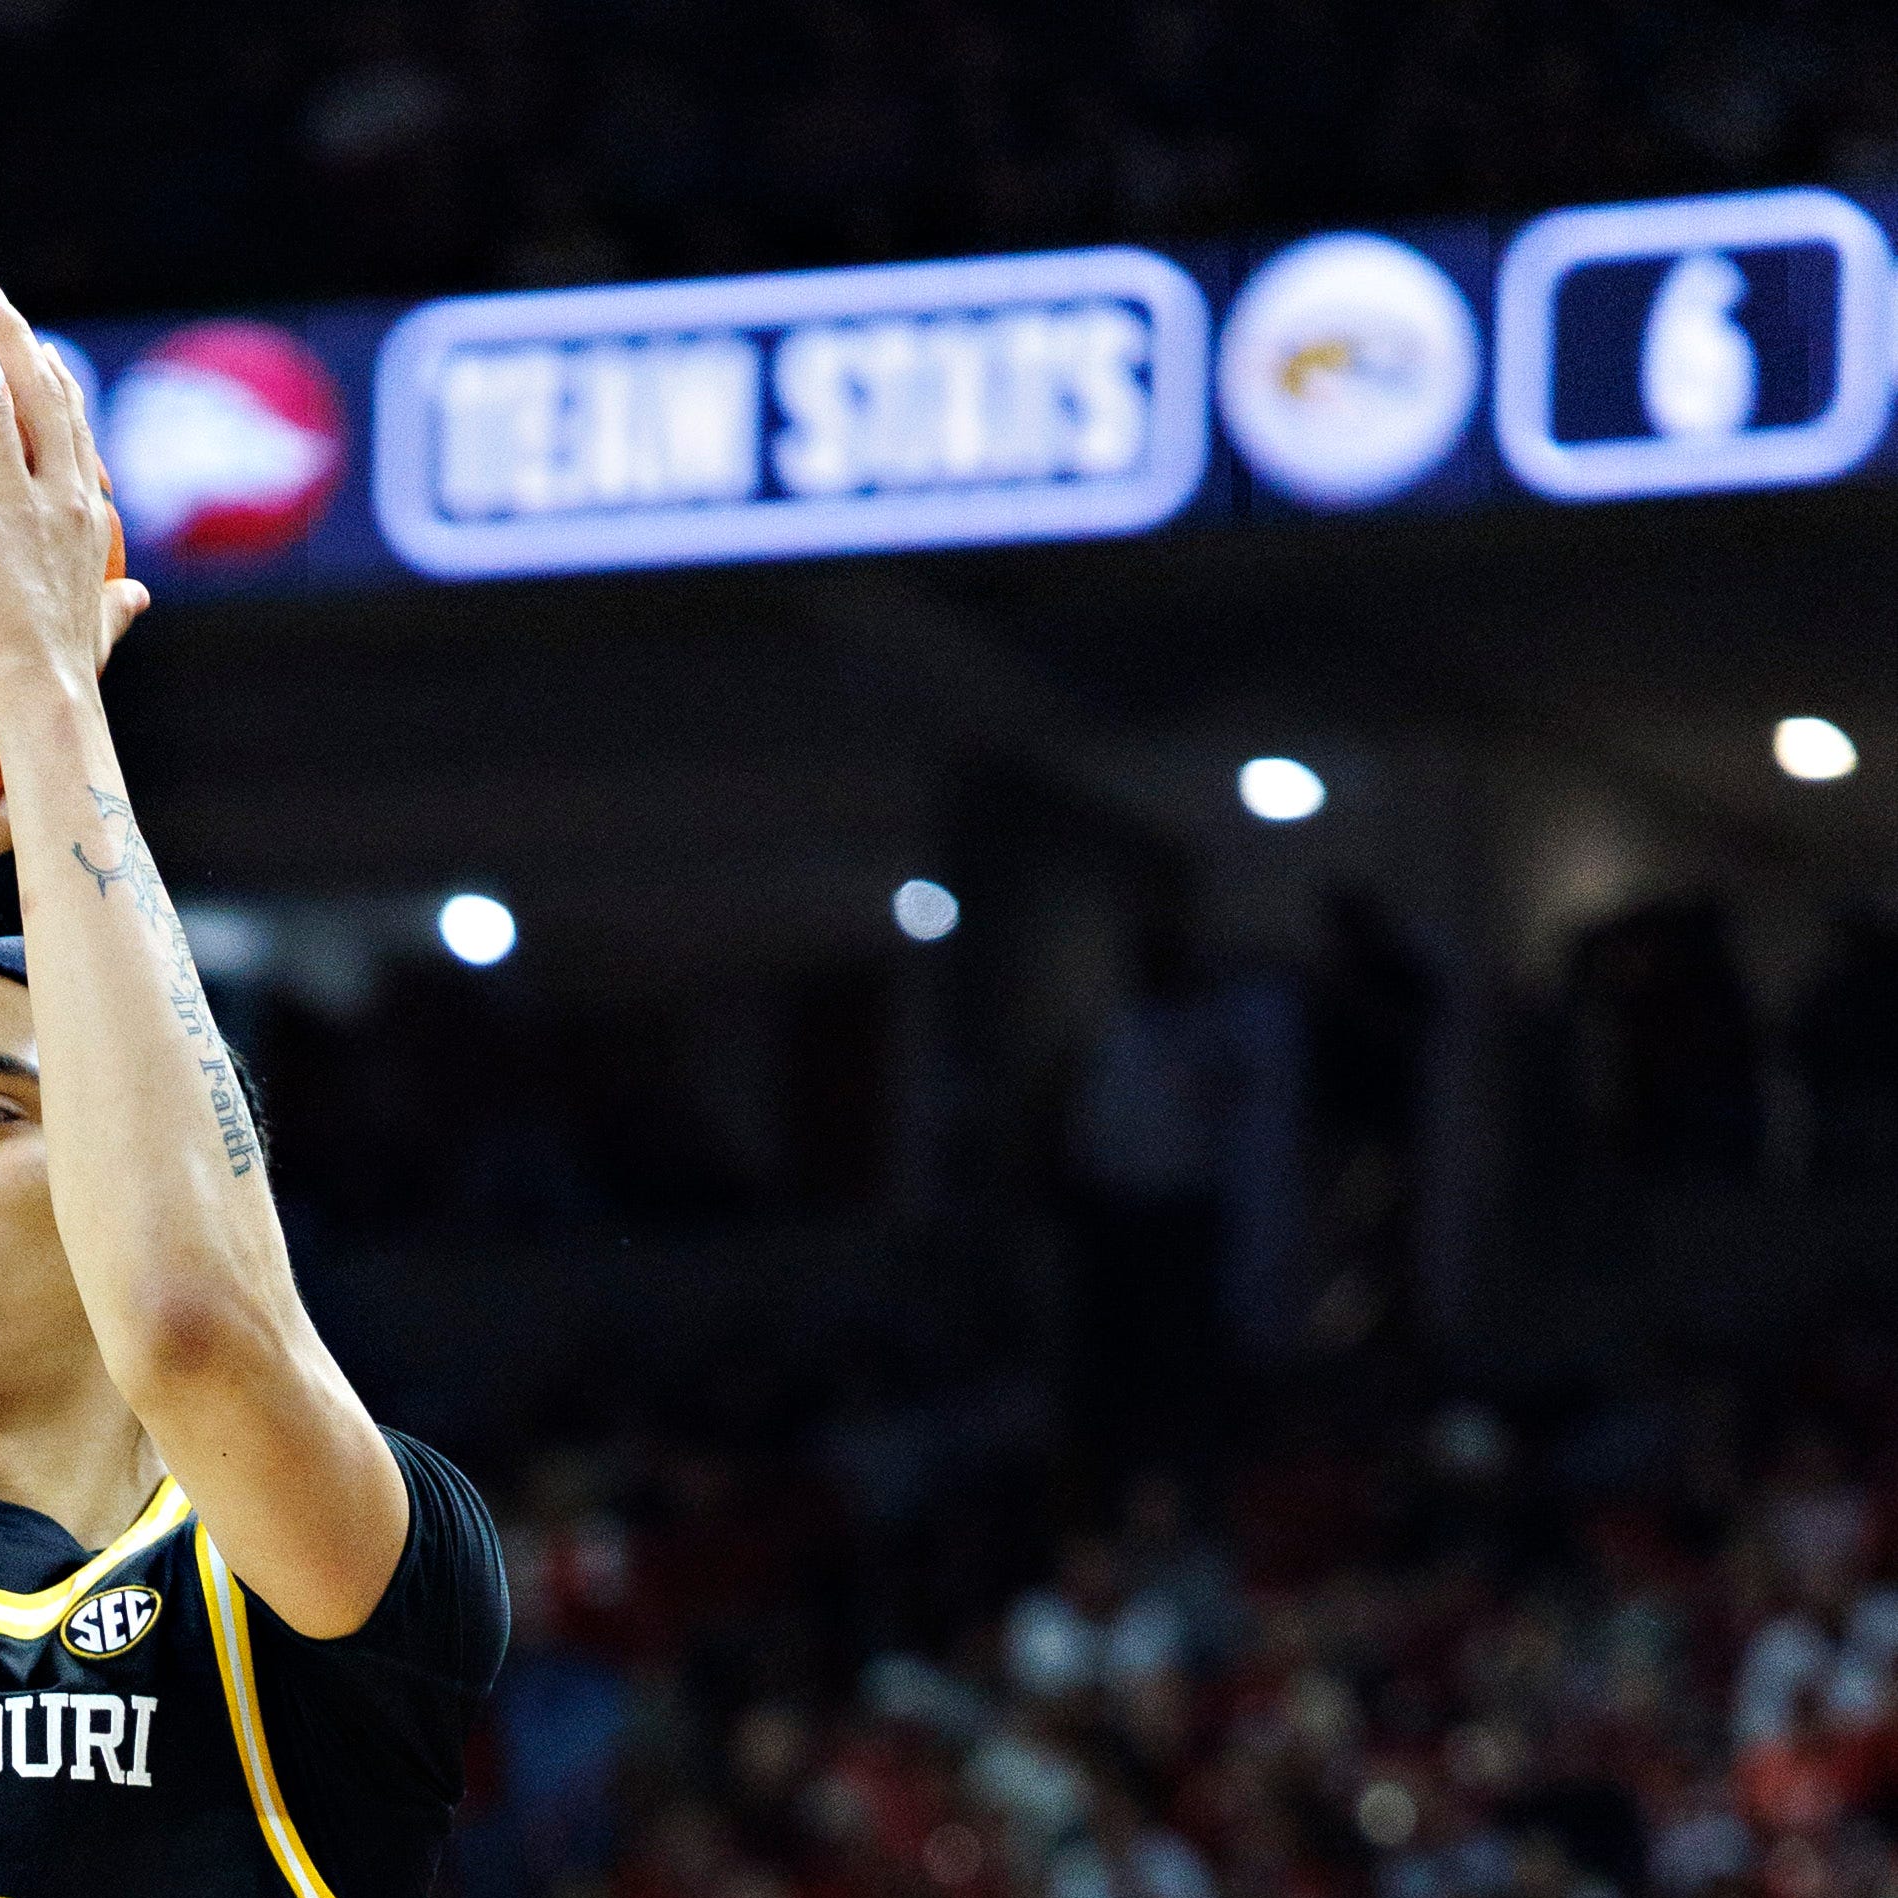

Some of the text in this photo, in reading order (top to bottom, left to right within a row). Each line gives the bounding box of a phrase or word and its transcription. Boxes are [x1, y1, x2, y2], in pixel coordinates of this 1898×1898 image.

[435, 302, 1152, 522] TEAM STATS
[1644, 250, 1758, 442] 6
[198, 1057, 256, 1178] Faith
[69, 1590, 153, 1653] SEC
